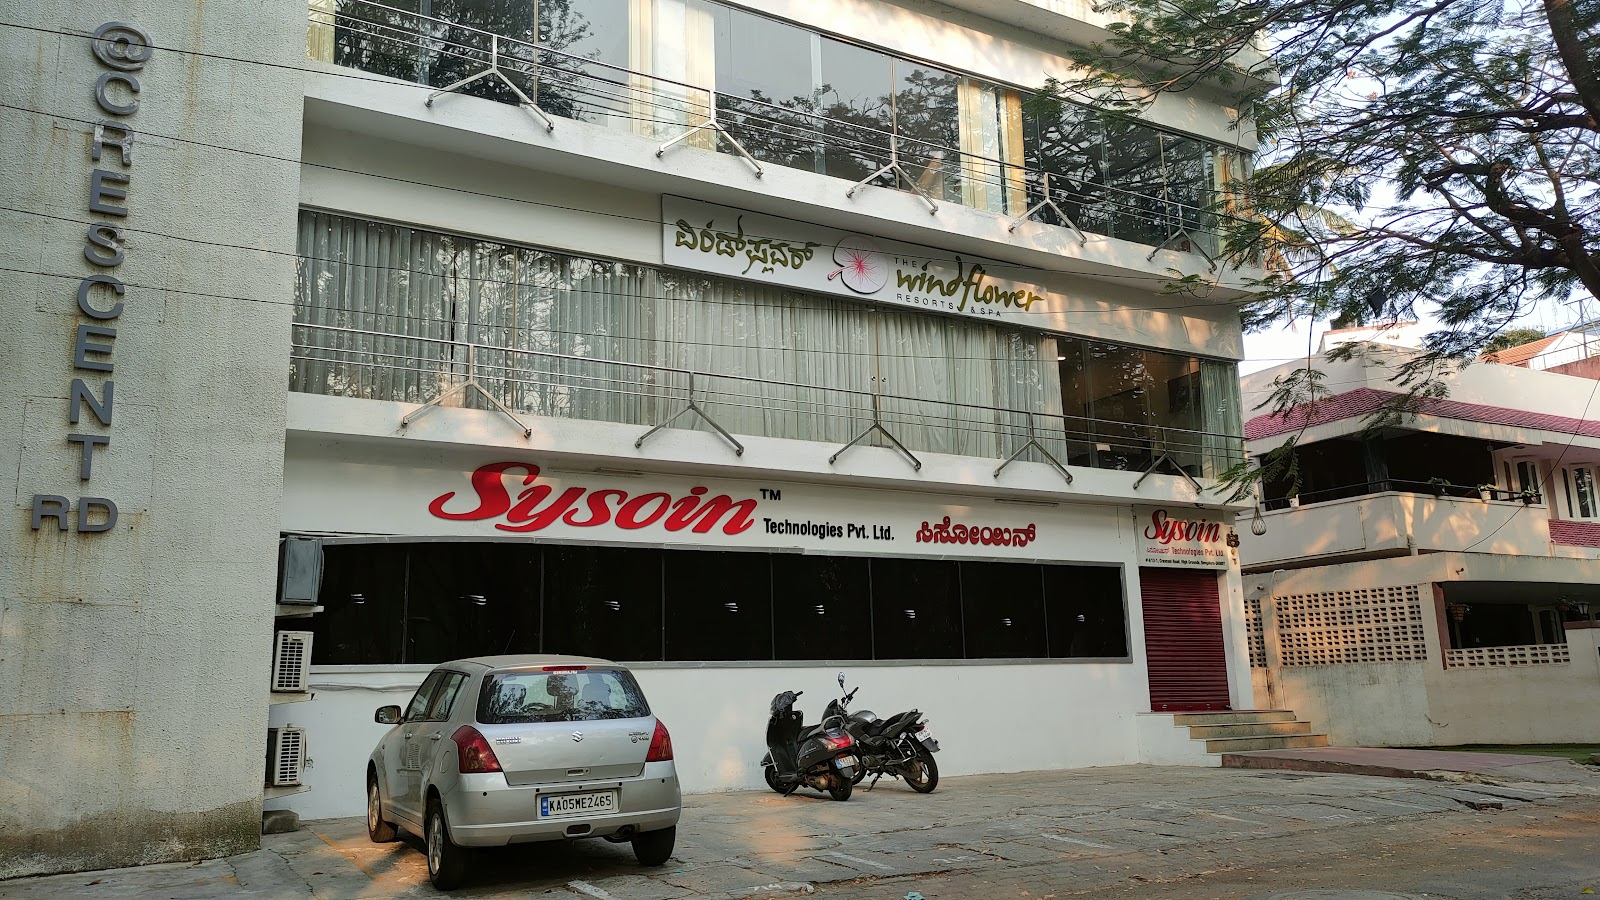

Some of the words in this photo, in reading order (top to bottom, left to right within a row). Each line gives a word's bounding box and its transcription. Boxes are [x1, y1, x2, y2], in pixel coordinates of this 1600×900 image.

[894, 257, 917, 268] THE
[897, 256, 1045, 312] windflower
[897, 293, 954, 310] RESORTS
[970, 306, 977, 314] &
[980, 307, 1002, 317] SPA
[428, 461, 757, 536] Sysoin
[760, 489, 781, 500] TM
[31, 494, 119, 533] RD
[763, 518, 844, 540] Technologies
[847, 523, 870, 539] Pvt.
[873, 525, 895, 541] Ltd.
[1144, 509, 1219, 544] Sysoin
[1171, 546, 1204, 557] Technologies
[549, 795, 612, 812] KA05ME2465
